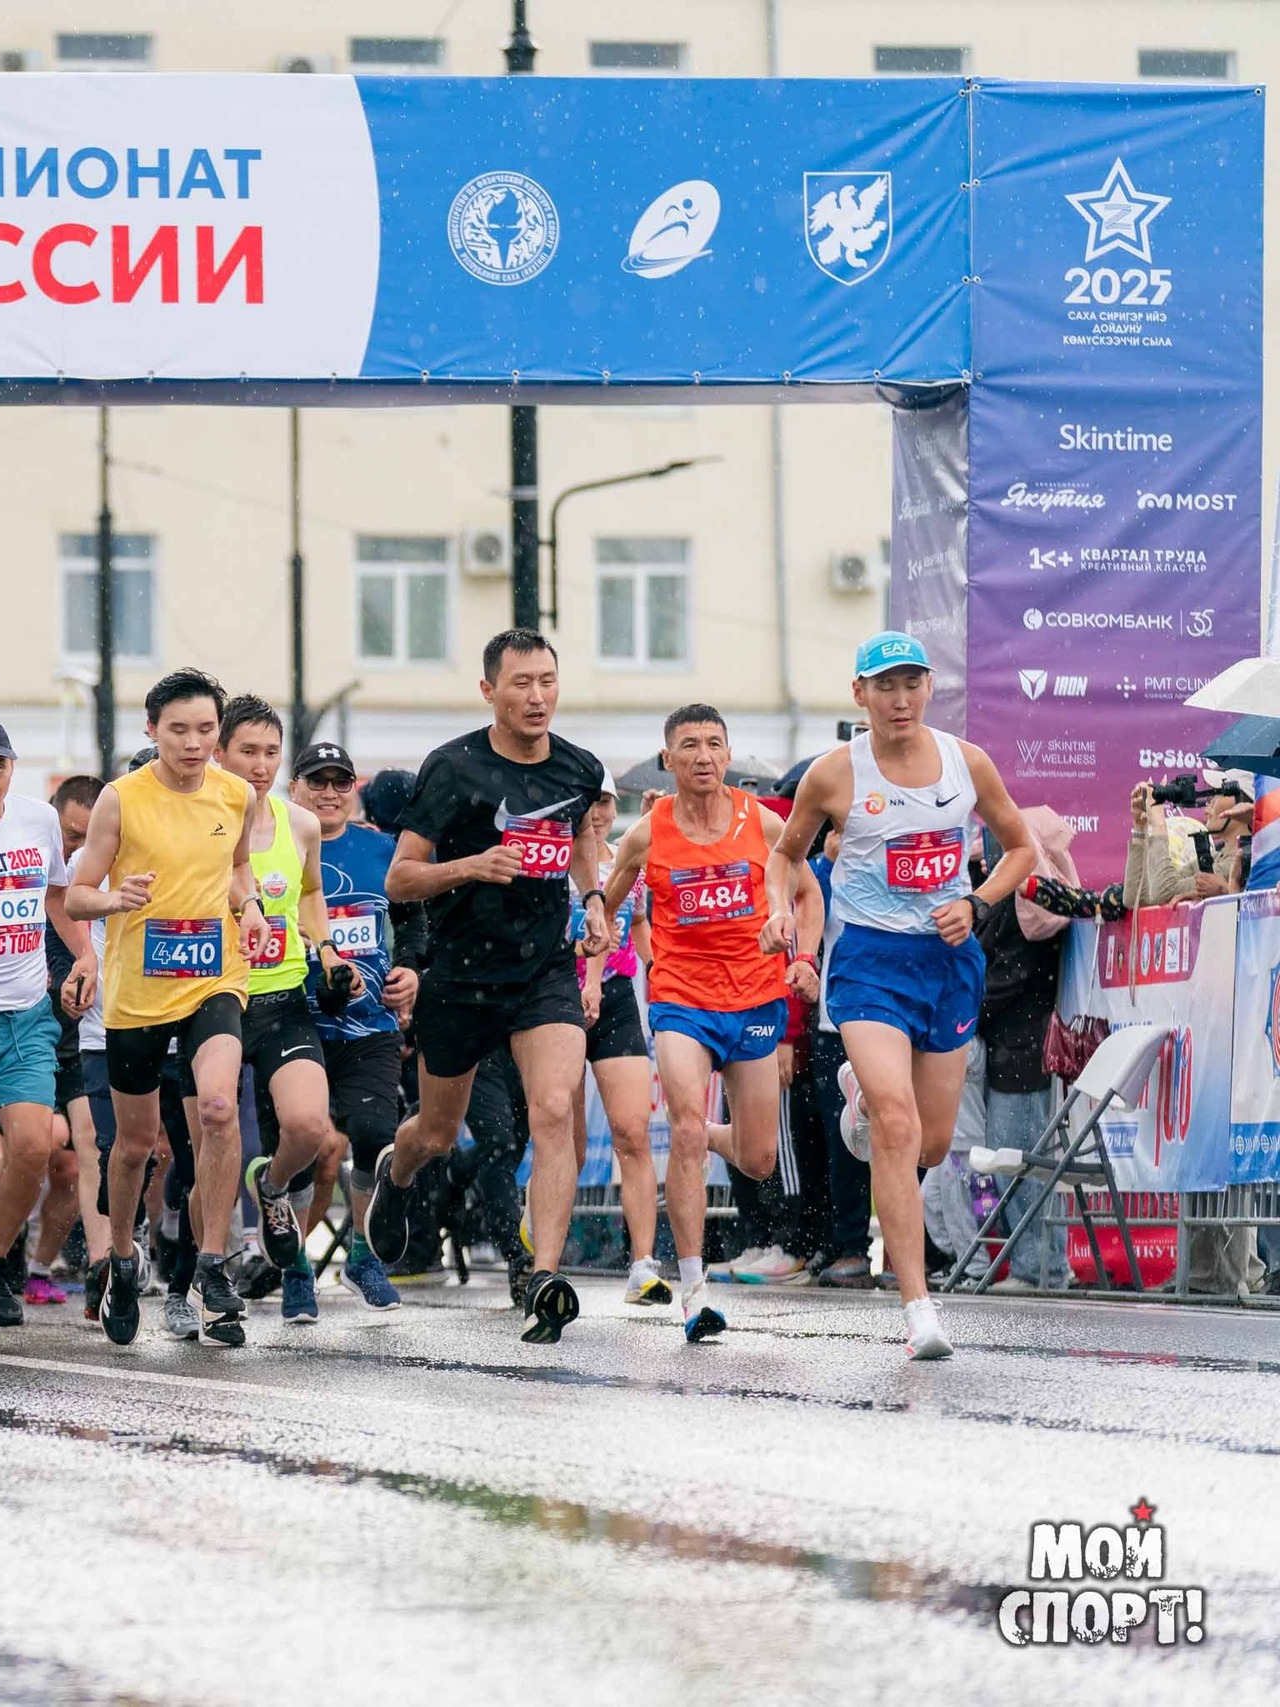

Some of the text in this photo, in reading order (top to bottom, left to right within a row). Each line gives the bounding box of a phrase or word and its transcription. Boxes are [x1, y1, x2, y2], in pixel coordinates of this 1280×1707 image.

[1063, 267, 1172, 305] 2025
[1067, 311, 1097, 320] САХА
[1099, 311, 1143, 321] СИРИГЭР
[1092, 322, 1142, 334] ДОЙДУНУ
[1142, 337, 1173, 347] СЫЛА
[1059, 424, 1172, 451] Skintime
[1000, 482, 1107, 513] Якутия
[1176, 494, 1238, 511] MOST
[1080, 548, 1207, 564] КВАРТАЛ ТРУДА
[1080, 562, 1207, 573] КРЕАТИВНЫЙ КЛАСТЕР
[1045, 613, 1173, 630] СОВКОМБАНК
[881, 643, 911, 655] EA7
[1053, 676, 1088, 697] IRON
[1145, 676, 1172, 690] PMT
[1048, 741, 1096, 751] SKINTIME
[1041, 755, 1097, 765] WELLNESS
[895, 853, 957, 882] 8419
[680, 884, 748, 913] 8484
[152, 941, 216, 965] 4410
[745, 1026, 775, 1036] RAV
